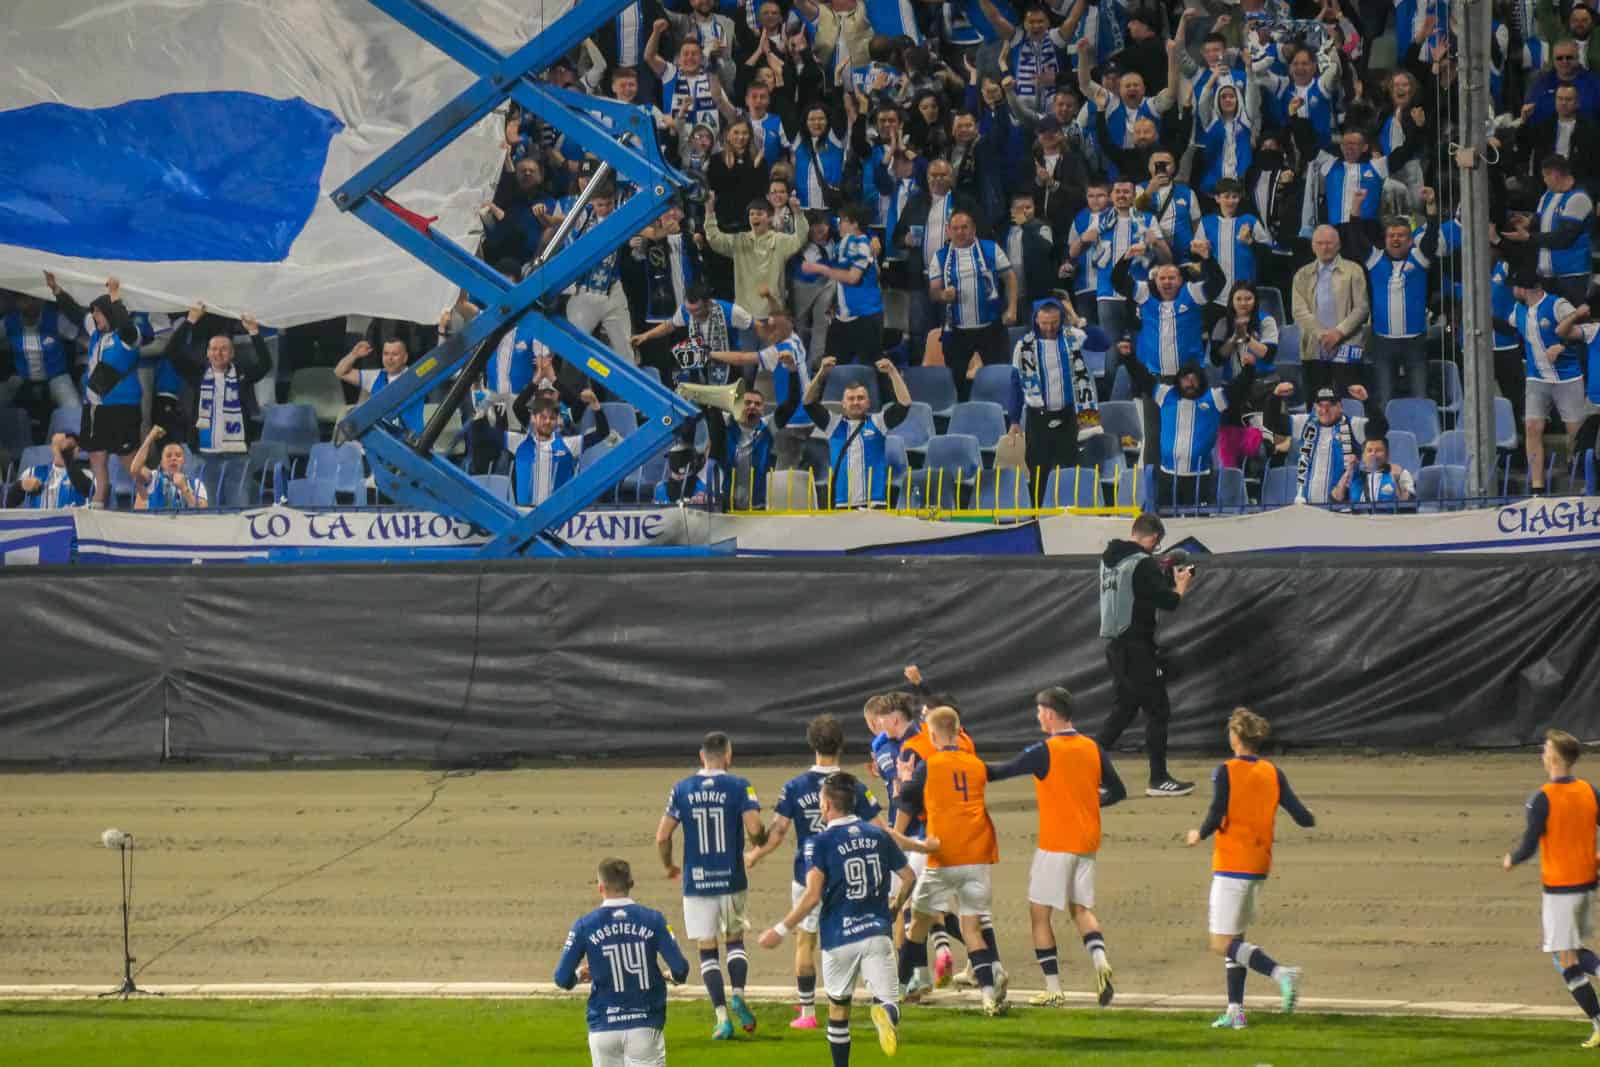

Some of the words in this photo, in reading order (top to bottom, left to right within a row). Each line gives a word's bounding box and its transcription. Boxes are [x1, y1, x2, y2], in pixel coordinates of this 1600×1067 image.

[246, 513, 291, 540] TO
[304, 513, 355, 540] TA
[952, 771, 969, 802] 4
[692, 807, 726, 854] 11
[803, 809, 827, 833] 3
[837, 838, 879, 855] OLEKSY
[844, 853, 884, 900] 91
[602, 941, 650, 993] 14
